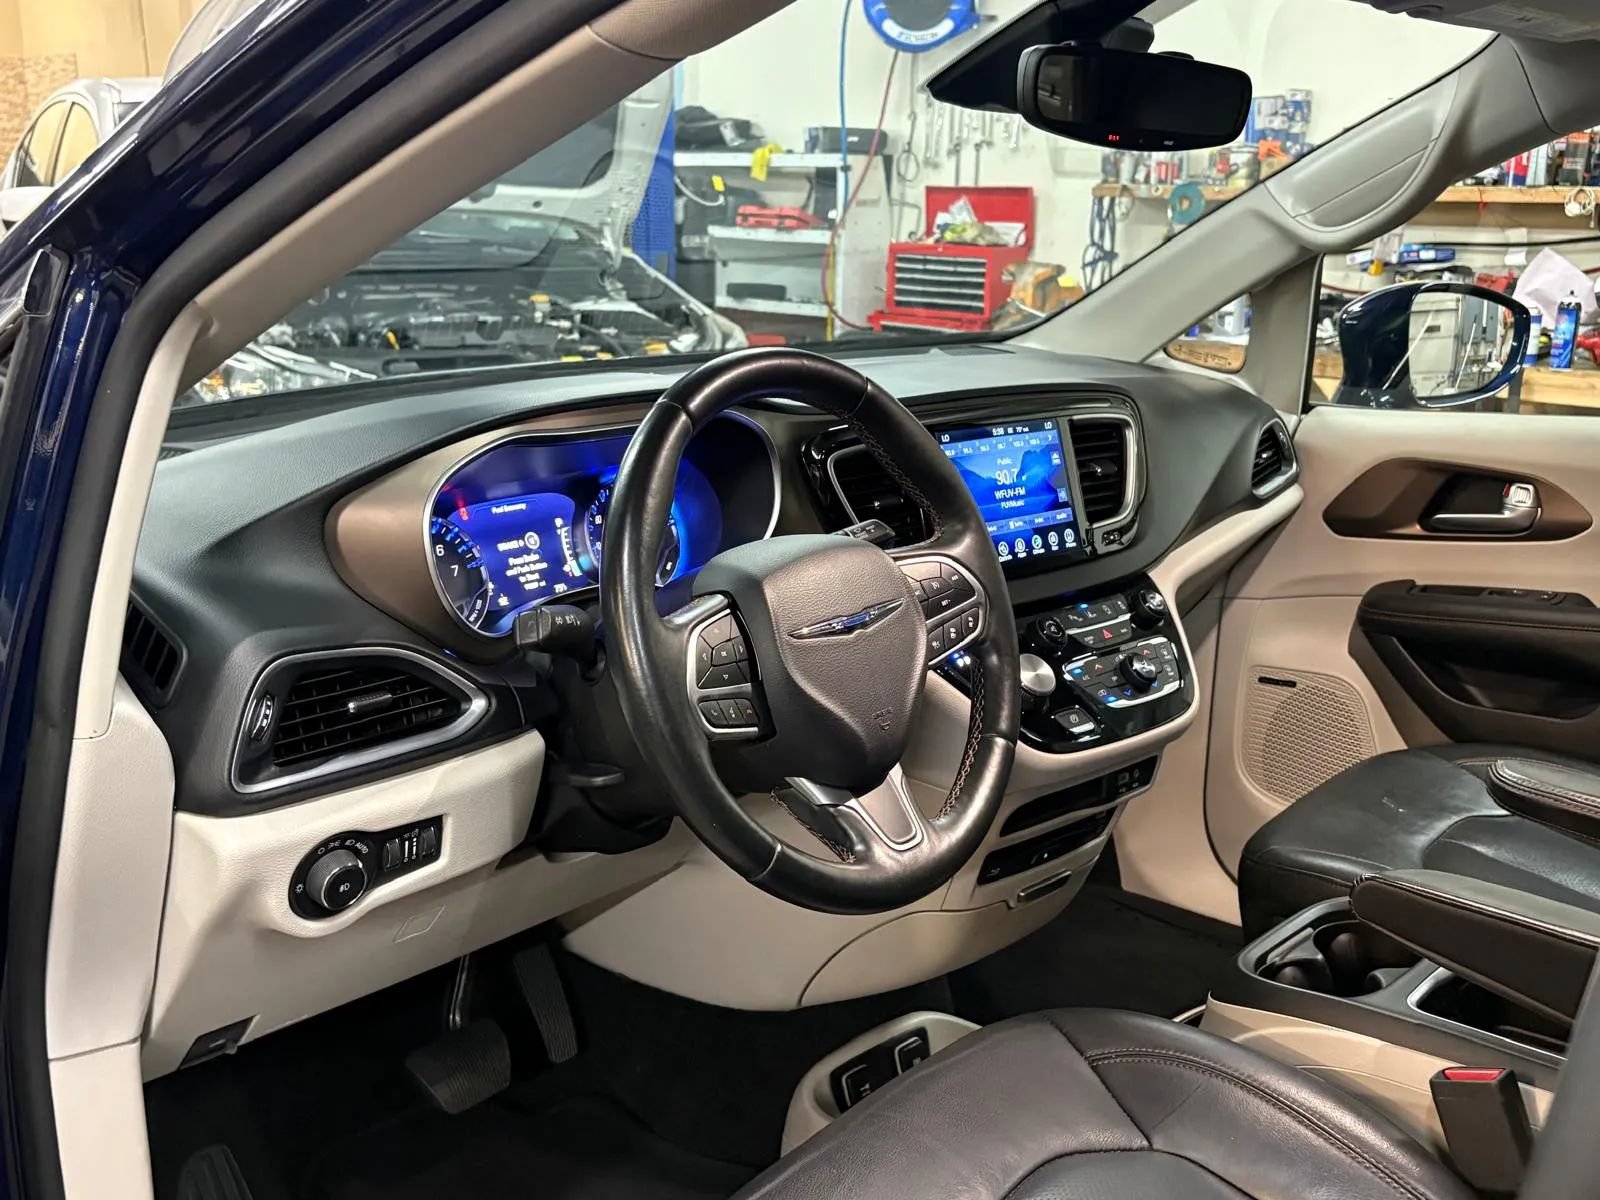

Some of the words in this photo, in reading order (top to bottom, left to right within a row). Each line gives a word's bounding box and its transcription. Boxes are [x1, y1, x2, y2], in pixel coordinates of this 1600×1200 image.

[941, 434, 950, 443] LO
[995, 468, 1018, 486] 90.7
[994, 487, 1026, 500] WFUV-FM
[435, 544, 445, 556] 6
[450, 564, 459, 577] 7
[355, 841, 369, 855] AUTO
